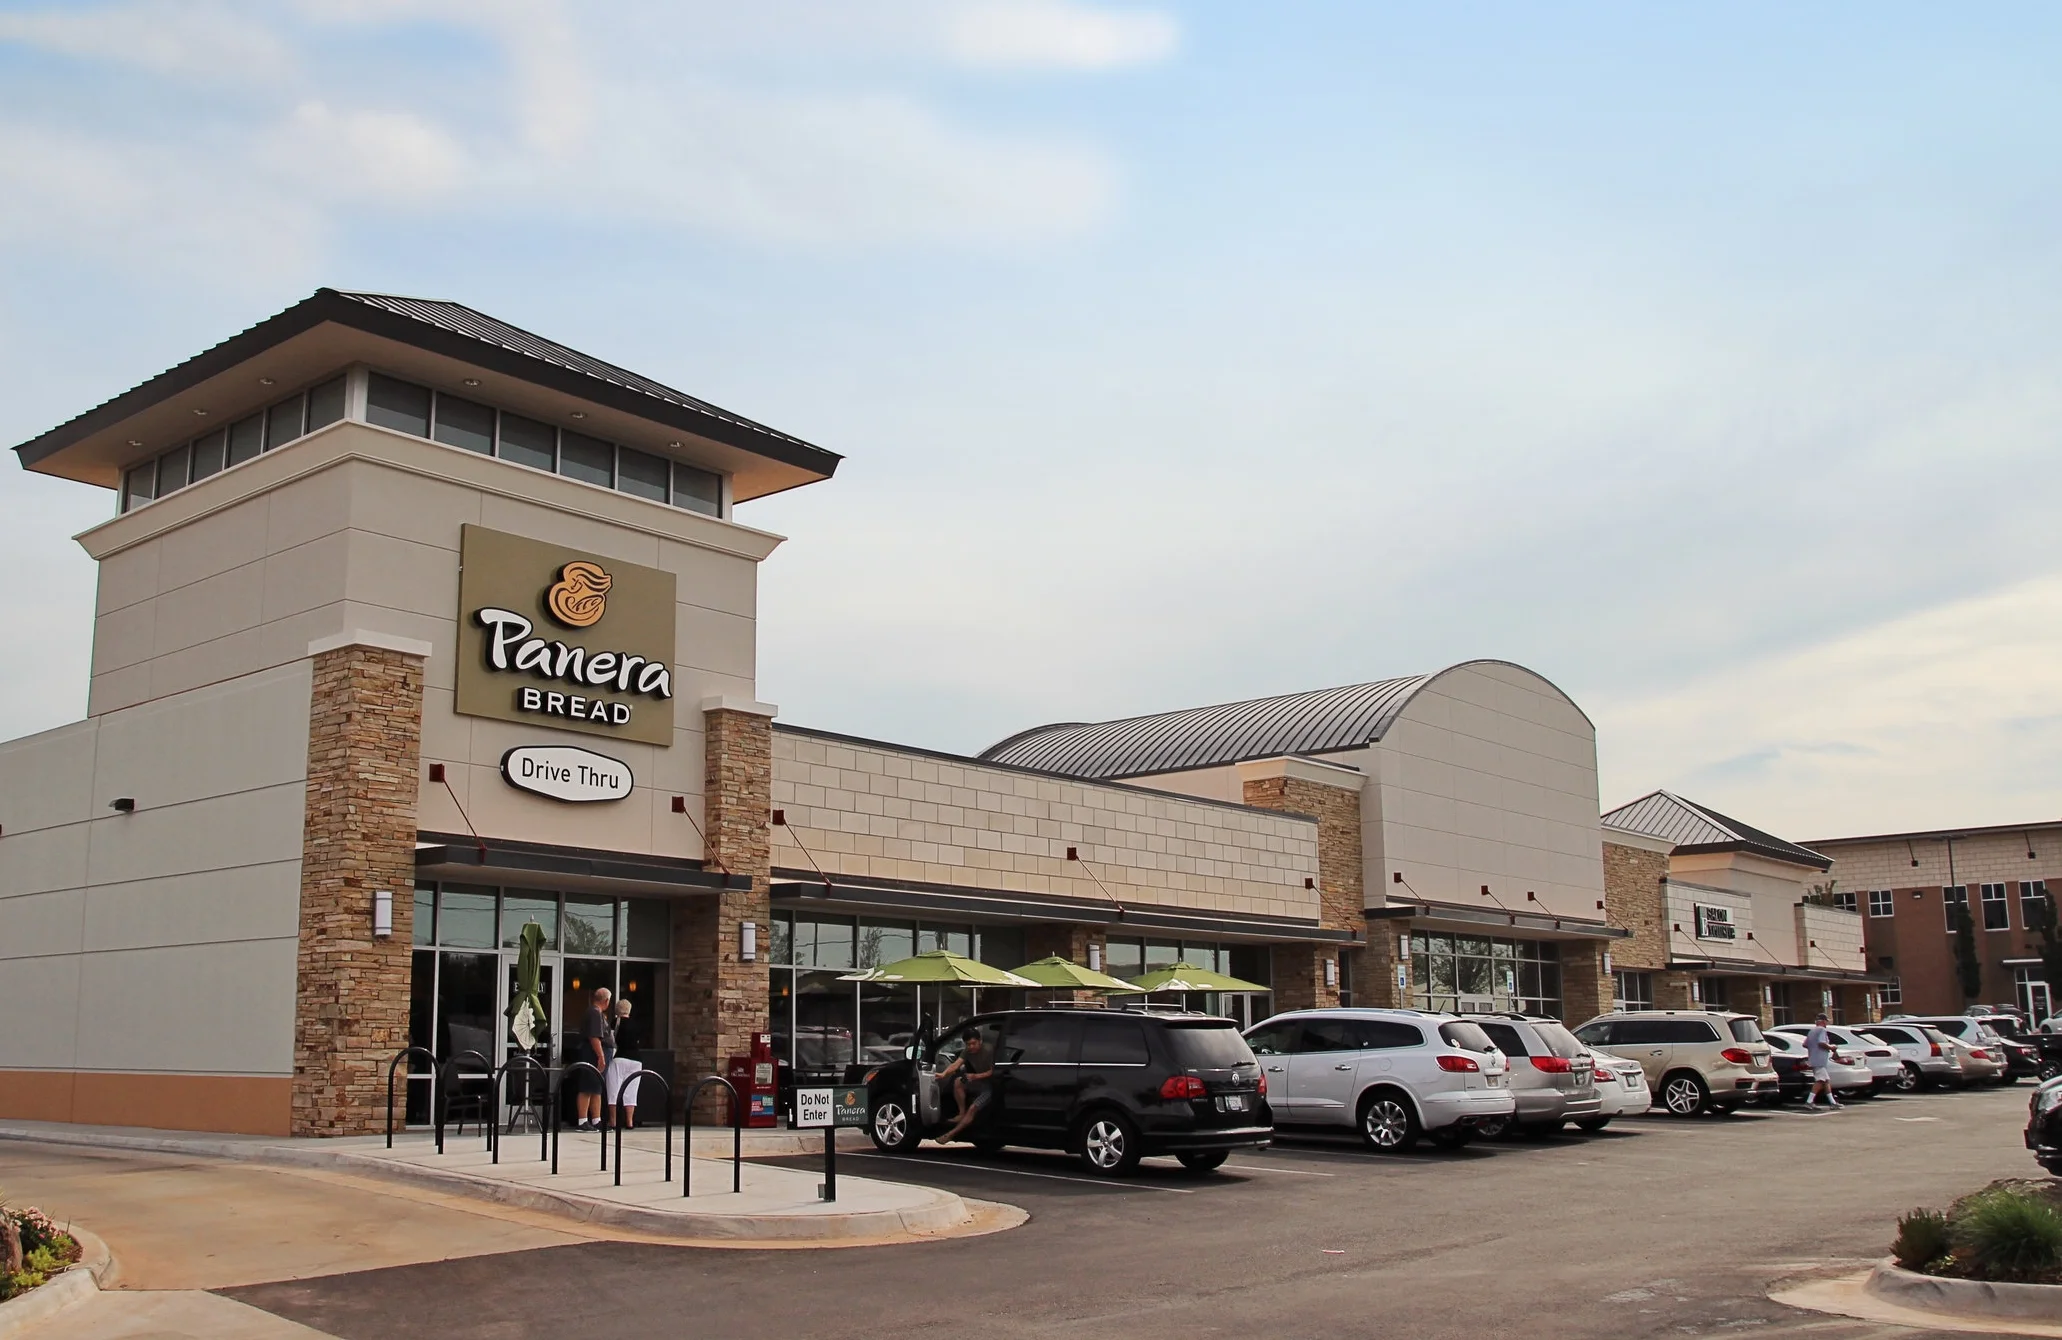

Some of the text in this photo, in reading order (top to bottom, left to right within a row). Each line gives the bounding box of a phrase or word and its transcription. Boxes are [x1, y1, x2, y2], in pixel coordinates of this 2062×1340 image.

[478, 606, 672, 698] Panera
[522, 686, 631, 725] BREAD
[521, 757, 619, 789] Drive Thru
[800, 1093, 830, 1105] Do Not
[835, 1104, 866, 1115] Panera
[803, 1109, 827, 1121] Enter
